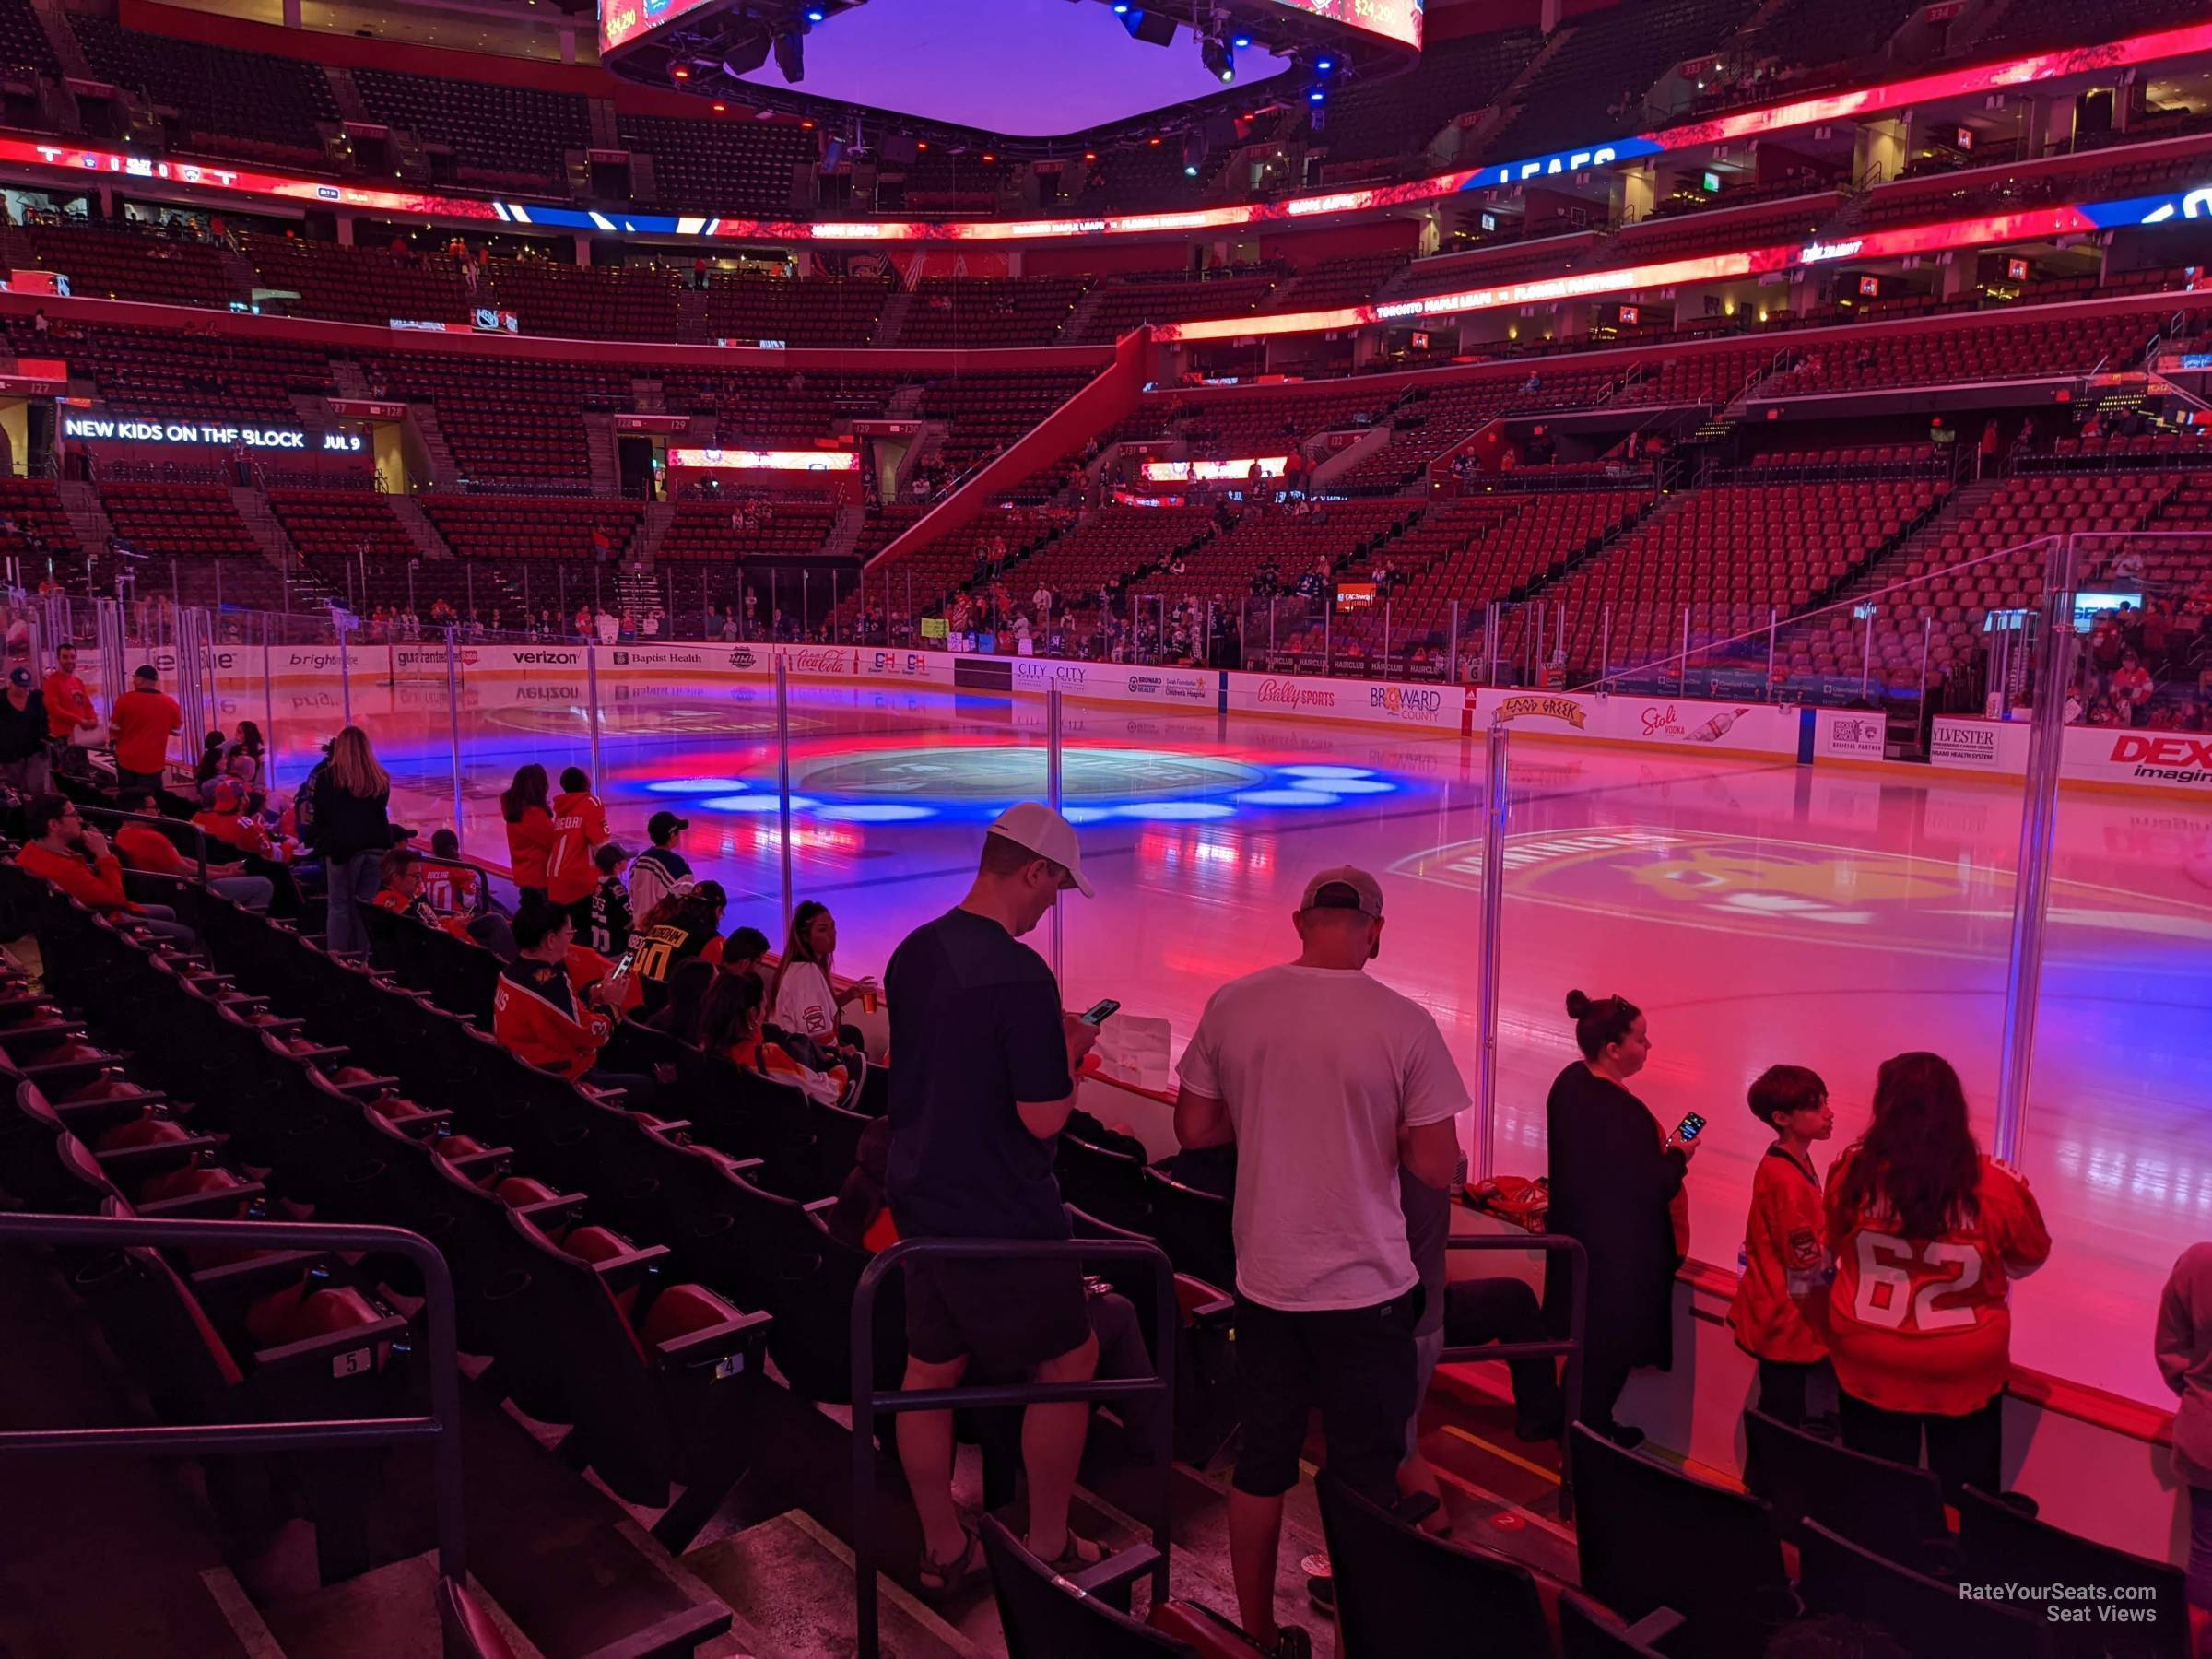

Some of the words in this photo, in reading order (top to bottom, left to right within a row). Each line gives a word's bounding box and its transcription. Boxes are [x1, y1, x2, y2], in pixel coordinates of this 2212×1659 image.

[1377, 301, 1423, 319] TORONTO
[1424, 297, 1459, 312] MAPLE
[1460, 291, 1492, 309] LEAFS
[1514, 280, 1566, 300] FLORIDA
[31, 383, 49, 394] 127
[671, 420, 686, 429] 129
[856, 424, 870, 432] 129
[66, 419, 114, 438] NEW
[118, 423, 163, 441] KIDS
[166, 426, 197, 442] ON
[202, 428, 238, 444] THE
[241, 429, 304, 447] BLOCK
[324, 435, 349, 450] JUL
[351, 437, 361, 451] 9
[1330, 436, 1343, 446] 132
[513, 651, 577, 665] verizon
[632, 653, 668, 665] Baptist
[670, 653, 702, 665] Health
[1334, 661, 1365, 669] HAIRCLUB
[1018, 663, 1047, 677] CITY
[1056, 666, 1086, 680] CITY
[1371, 663, 1404, 672] HAIRCLUB
[1257, 678, 1300, 710] Bally
[1300, 689, 1335, 707] SPORTS
[1371, 686, 1441, 712] BROWARD
[1401, 710, 1439, 722] COUNTY
[1543, 699, 1578, 721] GREEK
[1641, 705, 1677, 736] Stoli
[1665, 725, 1685, 735] VODKA
[1854, 1230, 1982, 1330] 62
[346, 1354, 359, 1373] 5
[724, 1357, 735, 1374] 4
